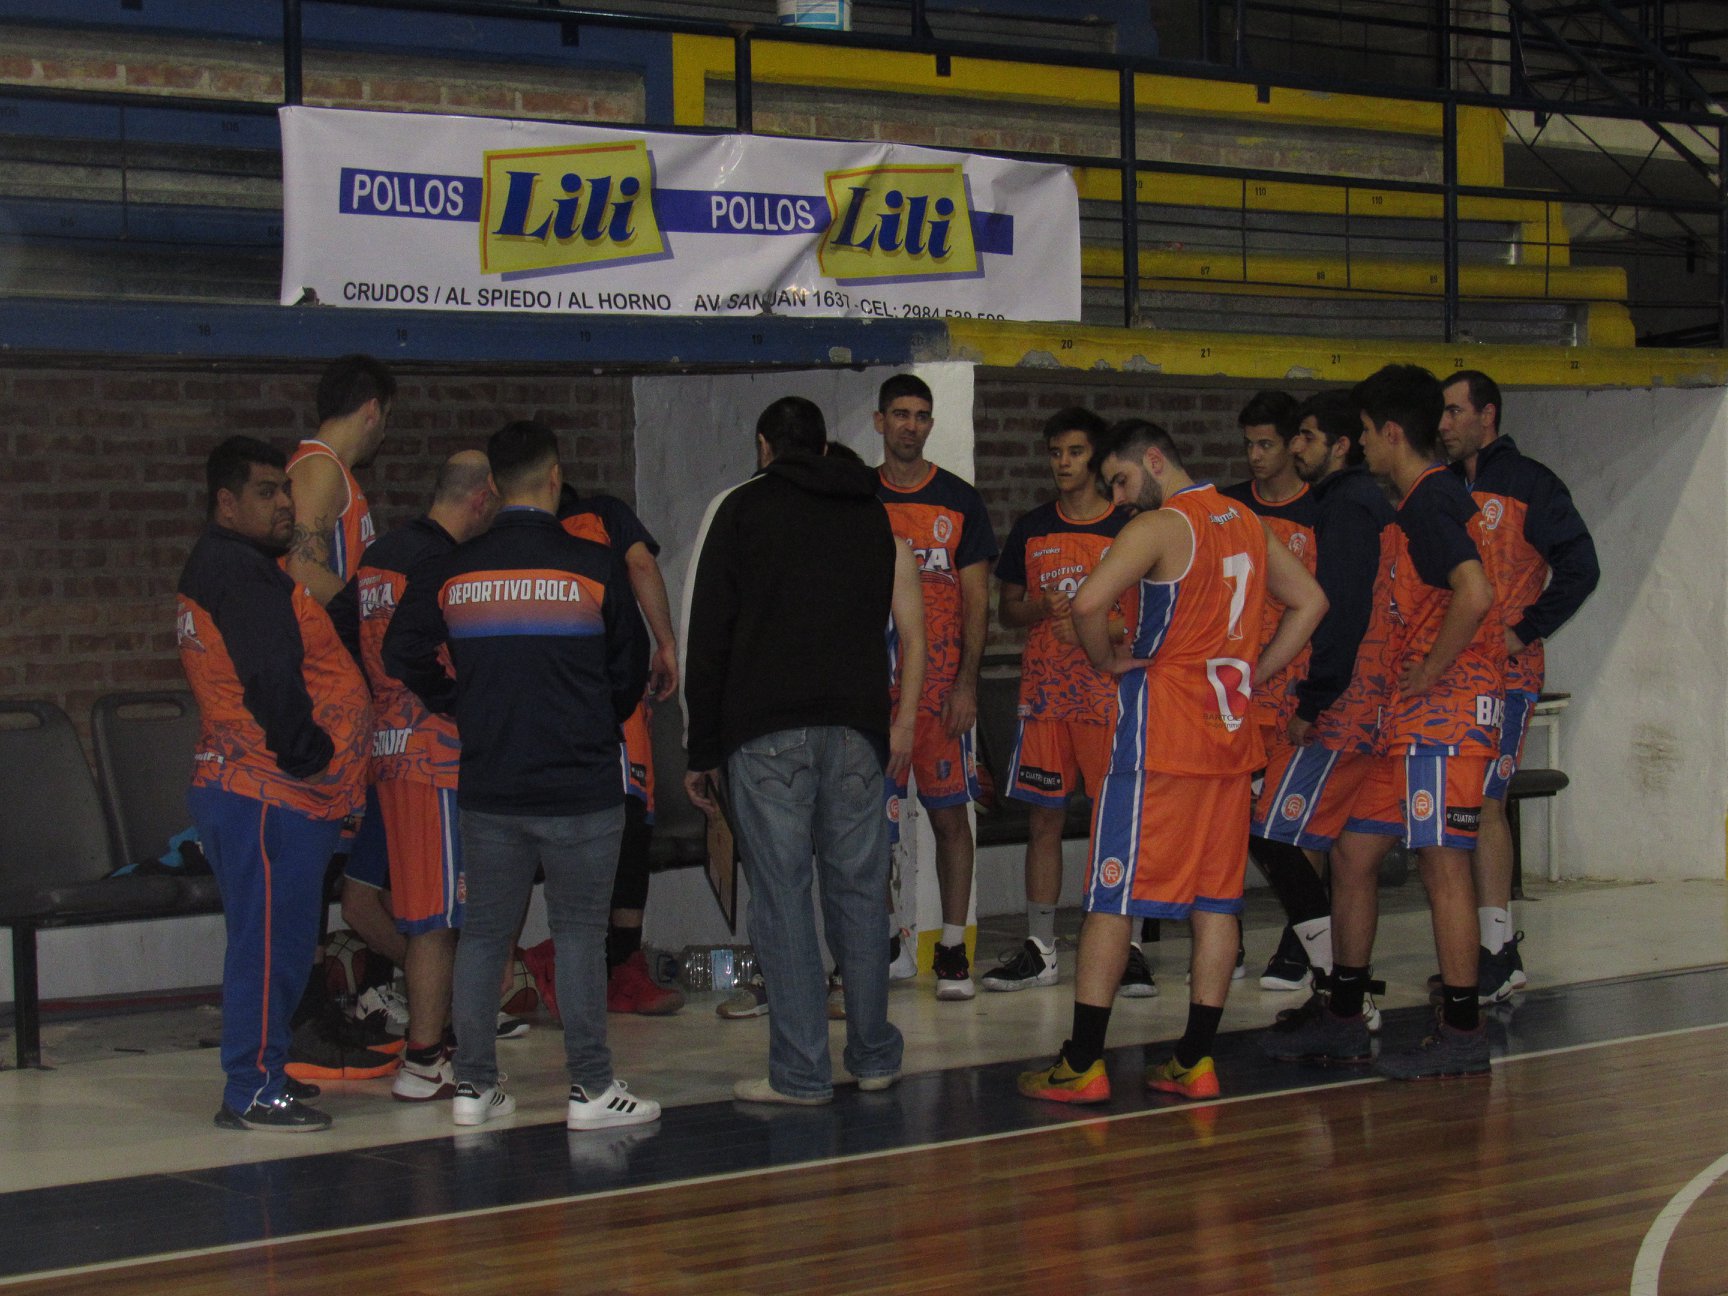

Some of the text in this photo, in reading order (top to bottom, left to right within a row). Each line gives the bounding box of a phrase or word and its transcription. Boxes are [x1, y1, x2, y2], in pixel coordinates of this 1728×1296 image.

[352, 174, 464, 216] POLLOS
[492, 171, 641, 241] Lili
[711, 196, 816, 231] POLLOS
[830, 187, 955, 258] Lili
[343, 282, 429, 303] CRUDOS
[445, 287, 471, 305] AL
[477, 289, 551, 308] SPIEDO
[568, 292, 594, 309] AL
[598, 293, 671, 311] HORNO
[813, 290, 849, 308] 1637
[1061, 339, 1073, 350] 20
[1200, 348, 1211, 358] 21
[1331, 354, 1341, 364] 21
[360, 582, 395, 617] ROCA
[449, 579, 580, 605] DEPORTIVO ROCA
